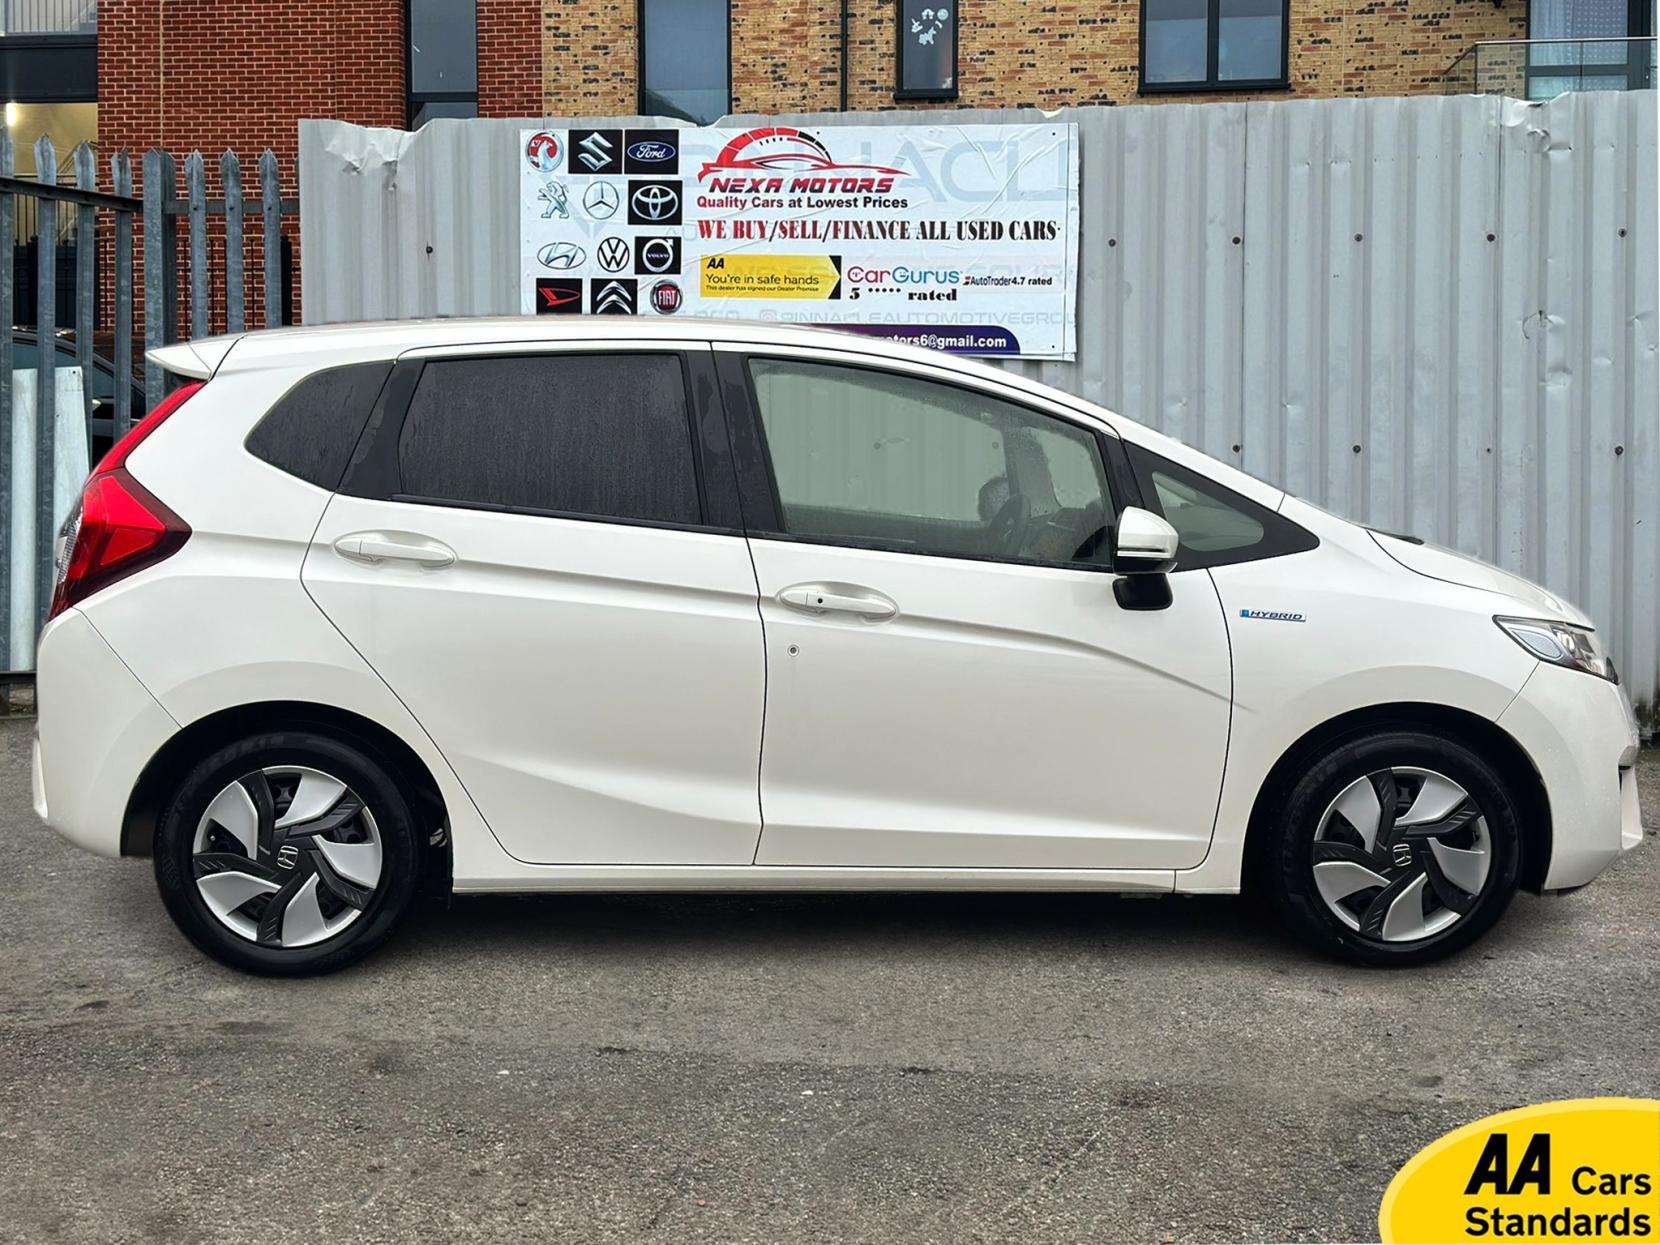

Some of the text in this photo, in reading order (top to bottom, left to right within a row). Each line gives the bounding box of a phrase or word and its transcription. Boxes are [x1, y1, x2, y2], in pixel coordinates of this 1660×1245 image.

[635, 144, 666, 158] Ford
[709, 177, 895, 194] NEXA MOTORS
[696, 196, 909, 211] Quality Cars at Lowest Prices
[697, 219, 727, 240] WE
[733, 219, 911, 242] BUY/SELL/FINANCE
[915, 220, 951, 241] ALL
[956, 220, 1004, 241] USED
[1008, 220, 1057, 241] CARS
[706, 257, 725, 269] AA
[705, 273, 820, 285] You're in safe hands
[846, 265, 960, 285] CarGurus
[1027, 276, 1053, 286] rated
[657, 289, 677, 306] FIAT
[849, 287, 958, 301] 5 rated
[1250, 610, 1303, 620] HYBRID
